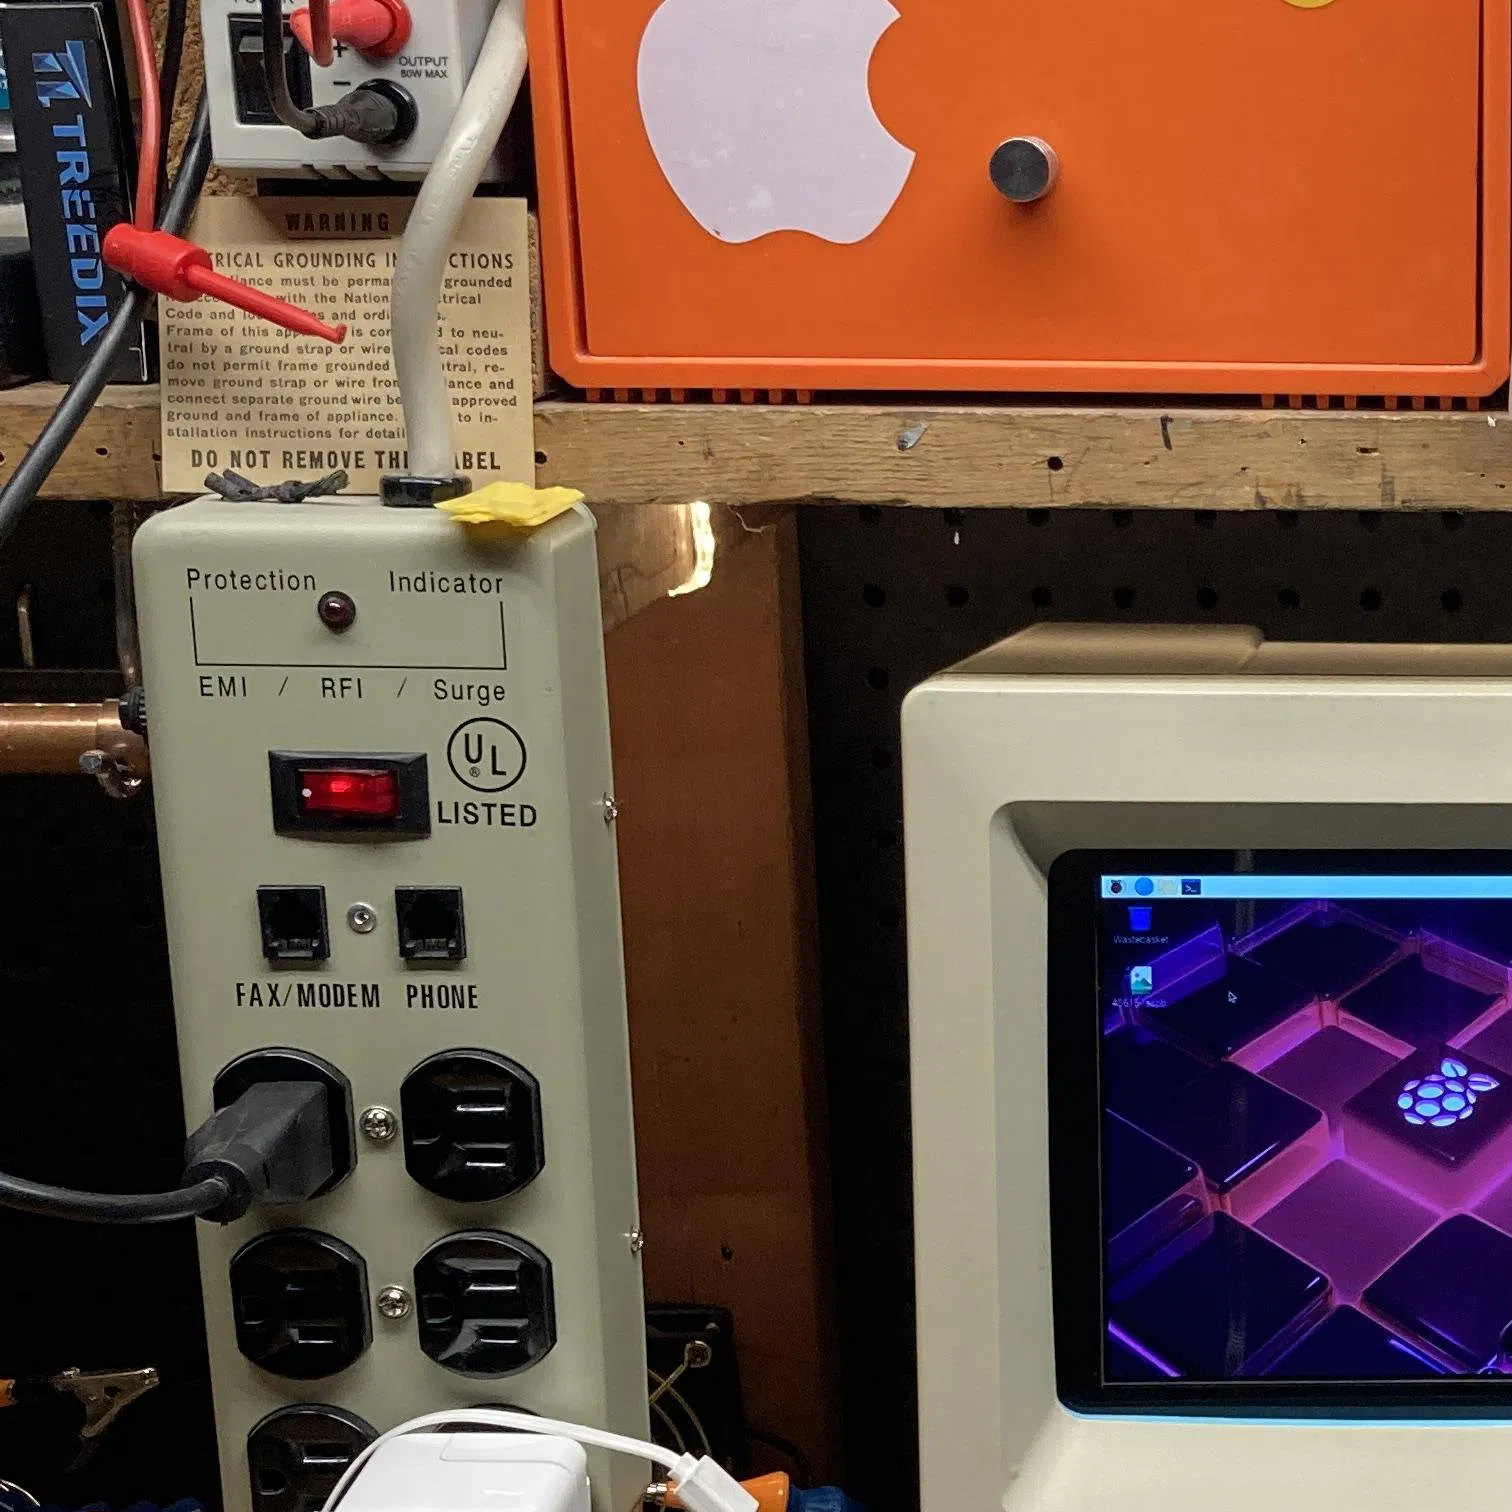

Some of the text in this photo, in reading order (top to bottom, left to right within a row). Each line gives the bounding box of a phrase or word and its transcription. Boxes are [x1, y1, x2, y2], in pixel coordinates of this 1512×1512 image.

[399, 56, 448, 67] OUTPUT
[425, 69, 448, 79] MAX
[285, 212, 390, 233] WARNING
[52, 113, 110, 347] TREEDIX
[274, 251, 376, 269] GROUNDING
[280, 276, 513, 289] must grounded
[314, 292, 337, 304] the
[165, 307, 235, 320] Code and
[331, 309, 356, 321] and
[165, 325, 269, 337] Frame this
[239, 343, 391, 356] ground strap wire
[466, 345, 509, 356] codes
[192, 360, 390, 373] not permit frame grounded
[167, 377, 306, 389] move ground strap
[488, 378, 515, 390] and
[166, 394, 348, 407] connect separate ground
[451, 395, 518, 408] approved
[166, 410, 219, 422] ground
[225, 411, 251, 422] and
[258, 411, 300, 422] frame
[166, 427, 332, 439] stallation instructions
[190, 449, 366, 470] DO NOT REMOVE
[186, 568, 318, 592] Protection
[389, 571, 504, 594] Indicator
[199, 677, 506, 706] EMI RFI Surge
[437, 801, 538, 828] LISTED
[235, 982, 479, 1009] FAX/MODEM PHONE
